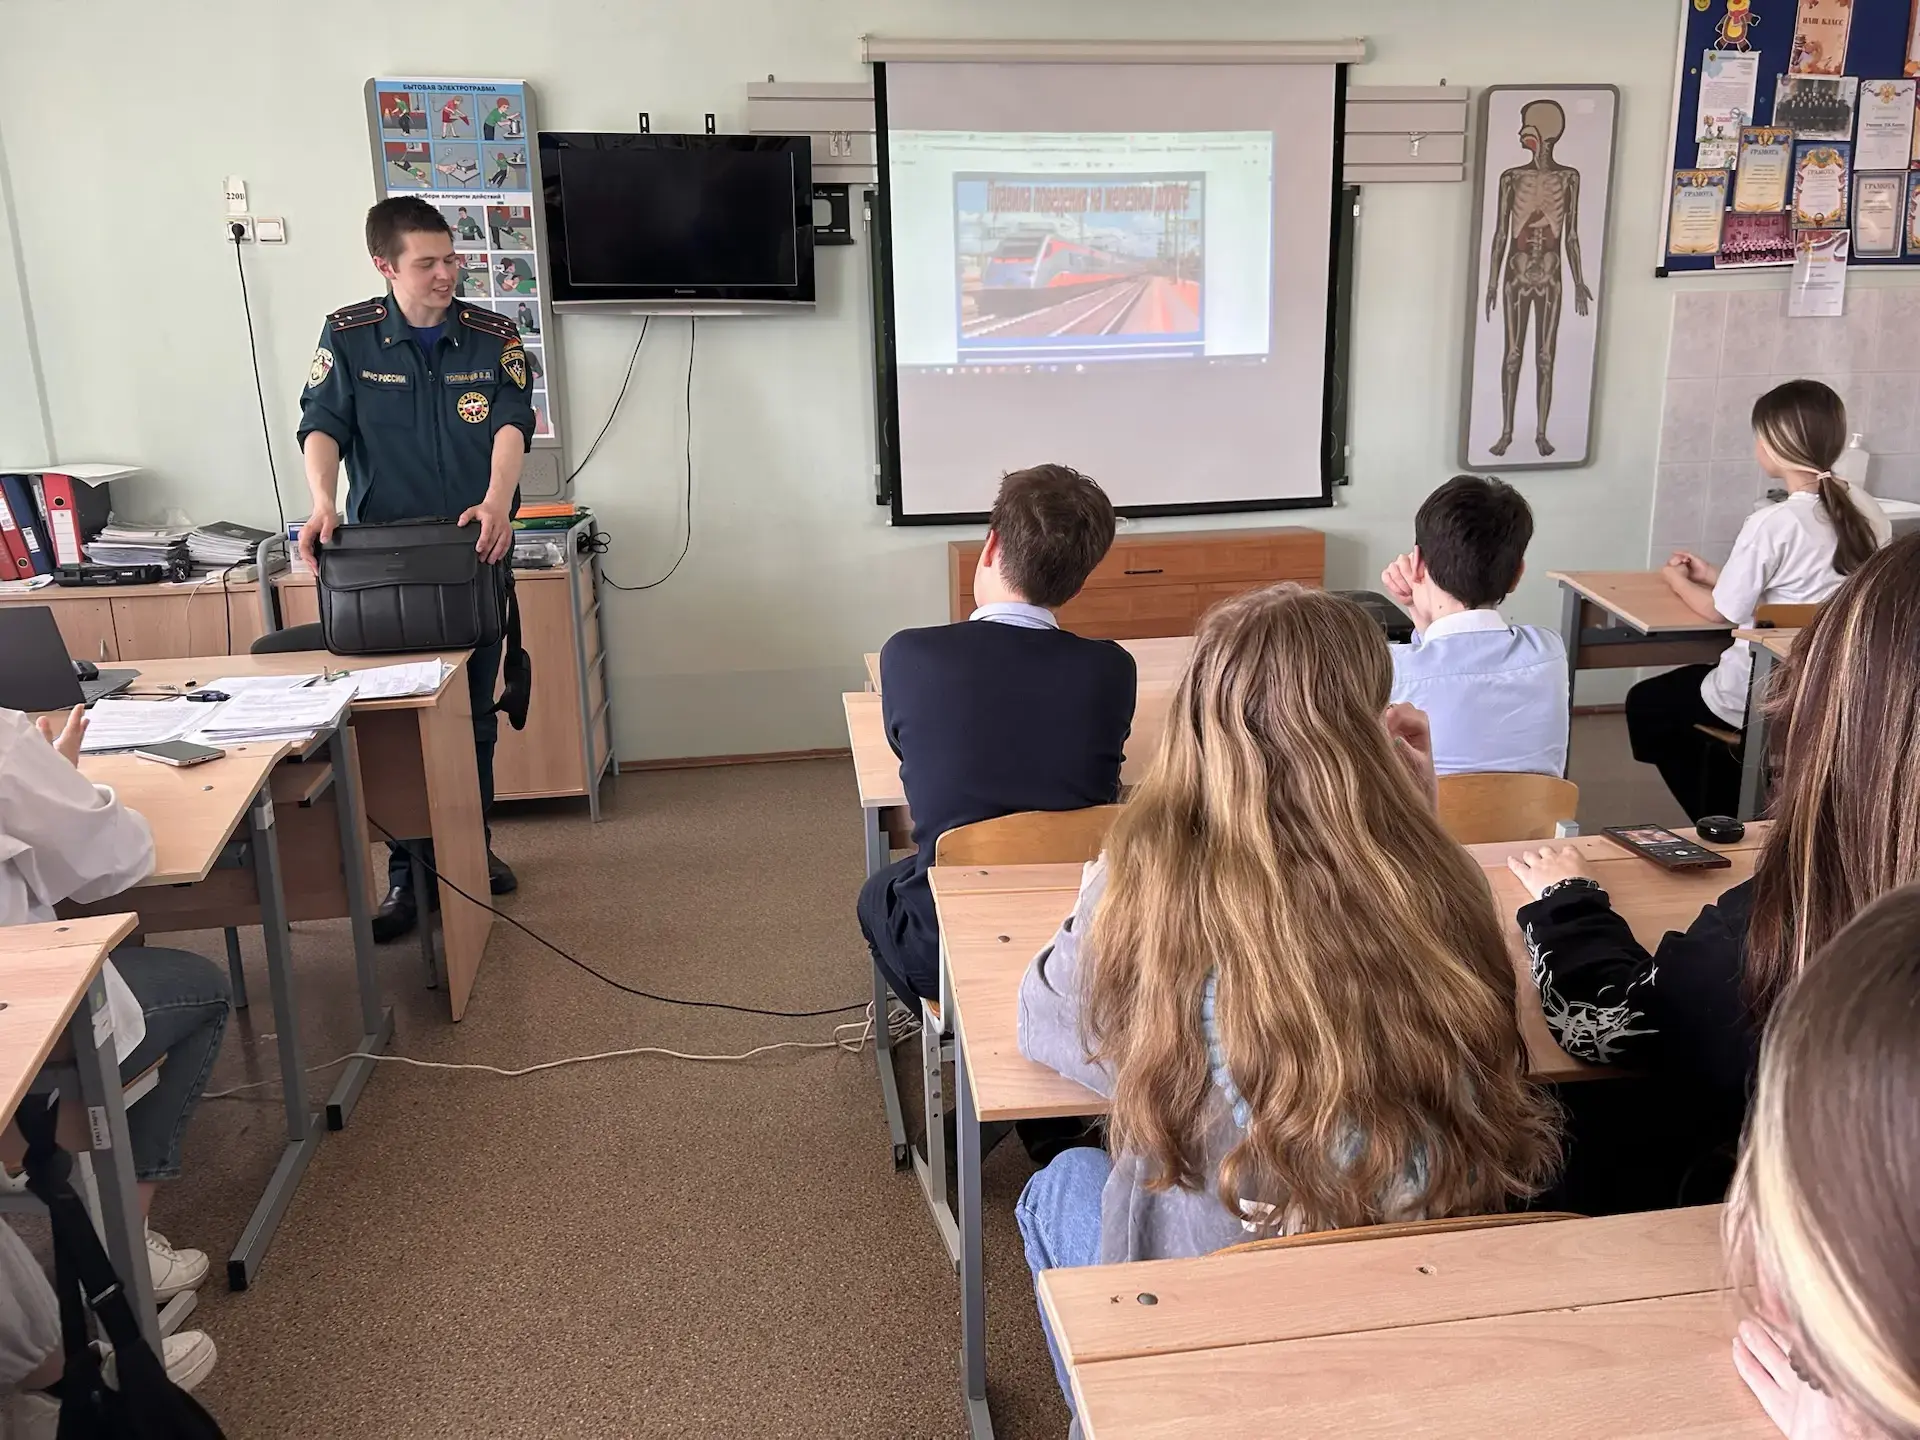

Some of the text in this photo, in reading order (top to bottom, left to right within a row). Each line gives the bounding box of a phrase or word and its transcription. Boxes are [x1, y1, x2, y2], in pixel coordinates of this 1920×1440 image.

[1802, 17, 1844, 26] НАШ КЛАСС
[402, 83, 496, 92] БЫТОВАЯ ЭЛЕКТРОТРАВМА
[1749, 148, 1779, 156] ГРАМОТА
[1683, 190, 1714, 198] ГРАМОТА
[362, 370, 406, 384] МЧС РОССИИ
